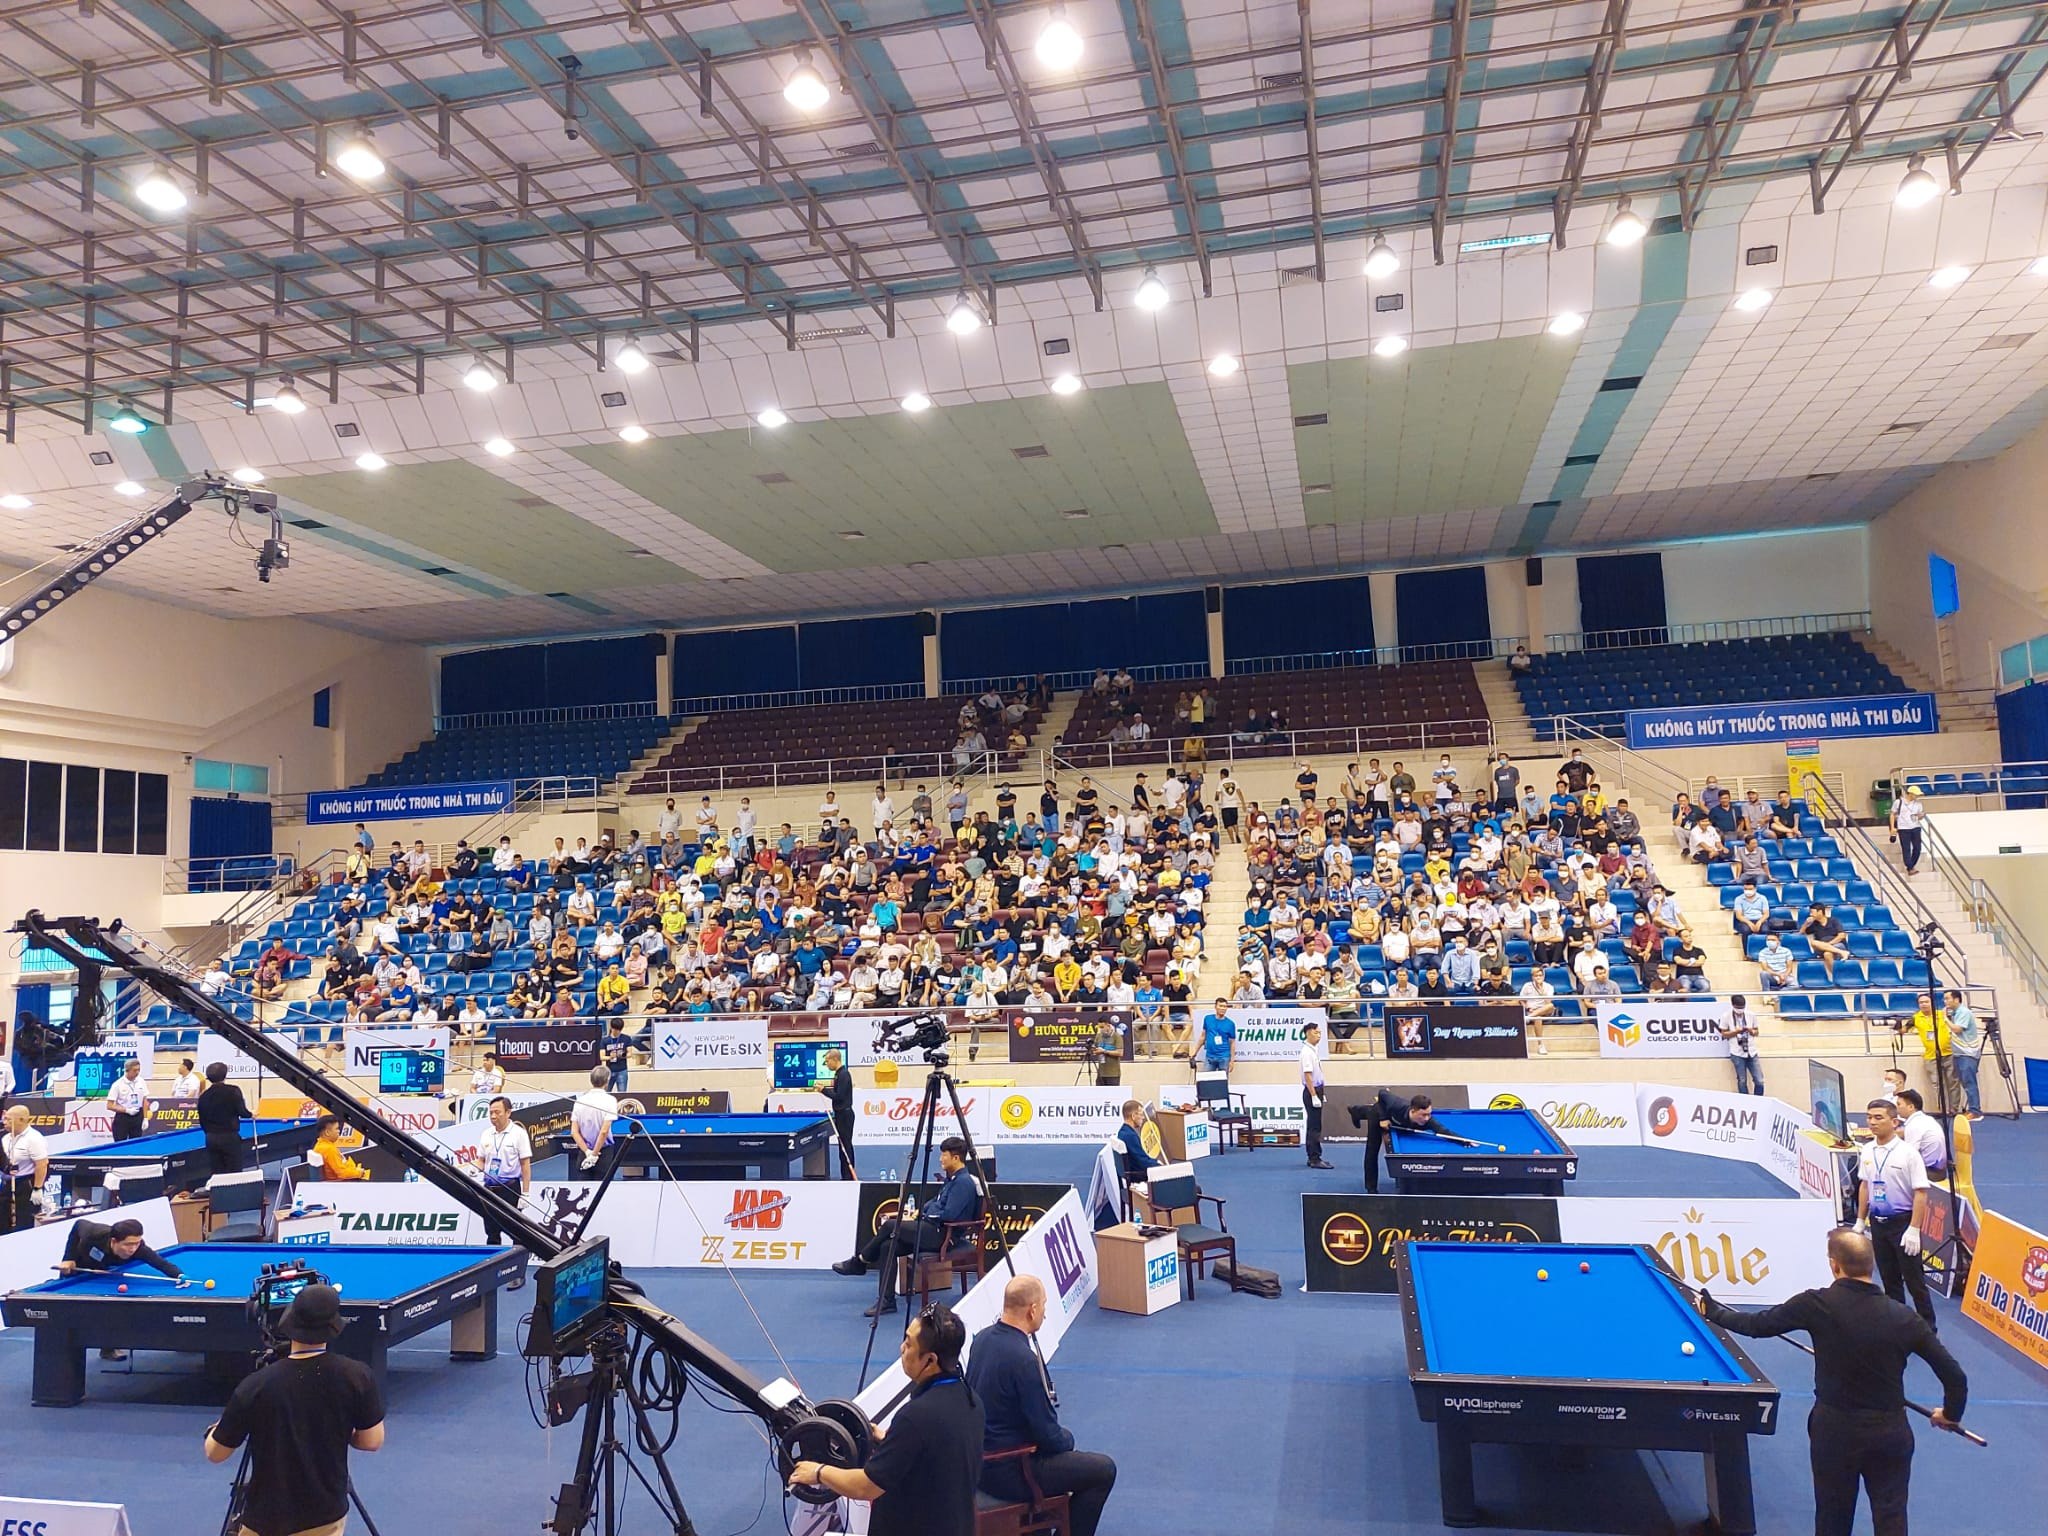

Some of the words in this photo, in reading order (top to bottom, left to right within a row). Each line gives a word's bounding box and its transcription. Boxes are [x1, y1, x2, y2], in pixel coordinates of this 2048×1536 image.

[1645, 719, 1694, 738] KHÔNG
[1697, 715, 1725, 735] HÚT
[1728, 710, 1776, 733] THUỐC
[1778, 713, 1828, 731] TRONG
[1830, 706, 1861, 728] NHÀ
[1864, 709, 1889, 726] THI
[1891, 701, 1922, 725] ĐẤU
[354, 796, 373, 813] HÚT
[375, 792, 407, 812] THUỐC
[408, 795, 441, 810] TRONG
[442, 790, 463, 808] NHÀ
[465, 793, 481, 807] THI
[483, 786, 504, 806] ĐẤU
[1265, 1017, 1305, 1025] BILLIARDS
[1646, 1018, 1722, 1035] CUEUN
[1059, 1036, 1079, 1045] HP
[1236, 1028, 1287, 1045] THẠNH
[103, 1040, 139, 1049] MATTRESS
[499, 1038, 534, 1058] theory
[549, 1039, 597, 1054] zonar
[694, 1042, 763, 1057] FIVE&SIX
[389, 1062, 403, 1074] 19
[420, 1060, 436, 1074] 28
[783, 1053, 801, 1068] 24
[85, 1067, 98, 1079] 33
[407, 1065, 417, 1074] 17
[656, 1095, 695, 1107] Billiard
[697, 1095, 711, 1106] 98
[376, 1107, 437, 1131] AKINO
[1038, 1105, 1064, 1118] KEN
[1541, 1100, 1628, 1129] Million
[1690, 1104, 1758, 1131] ADAM
[67, 1110, 114, 1134] AKIN
[1706, 1128, 1737, 1143] CLUB
[788, 1139, 796, 1150] 2
[1566, 1161, 1576, 1174] 8
[1799, 1146, 1832, 1199] AKINO
[337, 1212, 460, 1232] TAURUS
[1422, 1219, 1495, 1228] BILLIARDS
[387, 1235, 425, 1246] BILLIARD
[426, 1235, 455, 1245] CLOTH
[731, 1241, 807, 1260] ZEST
[1148, 1252, 1177, 1283] HBSF
[1975, 1272, 1992, 1301] Bi
[1990, 1282, 2009, 1313] Da
[378, 1314, 388, 1332] 1
[1558, 1404, 1615, 1415] INNOVATION
[1615, 1407, 1627, 1420] 2
[1597, 1413, 1615, 1421] CLUB
[1758, 1401, 1774, 1424] 7
